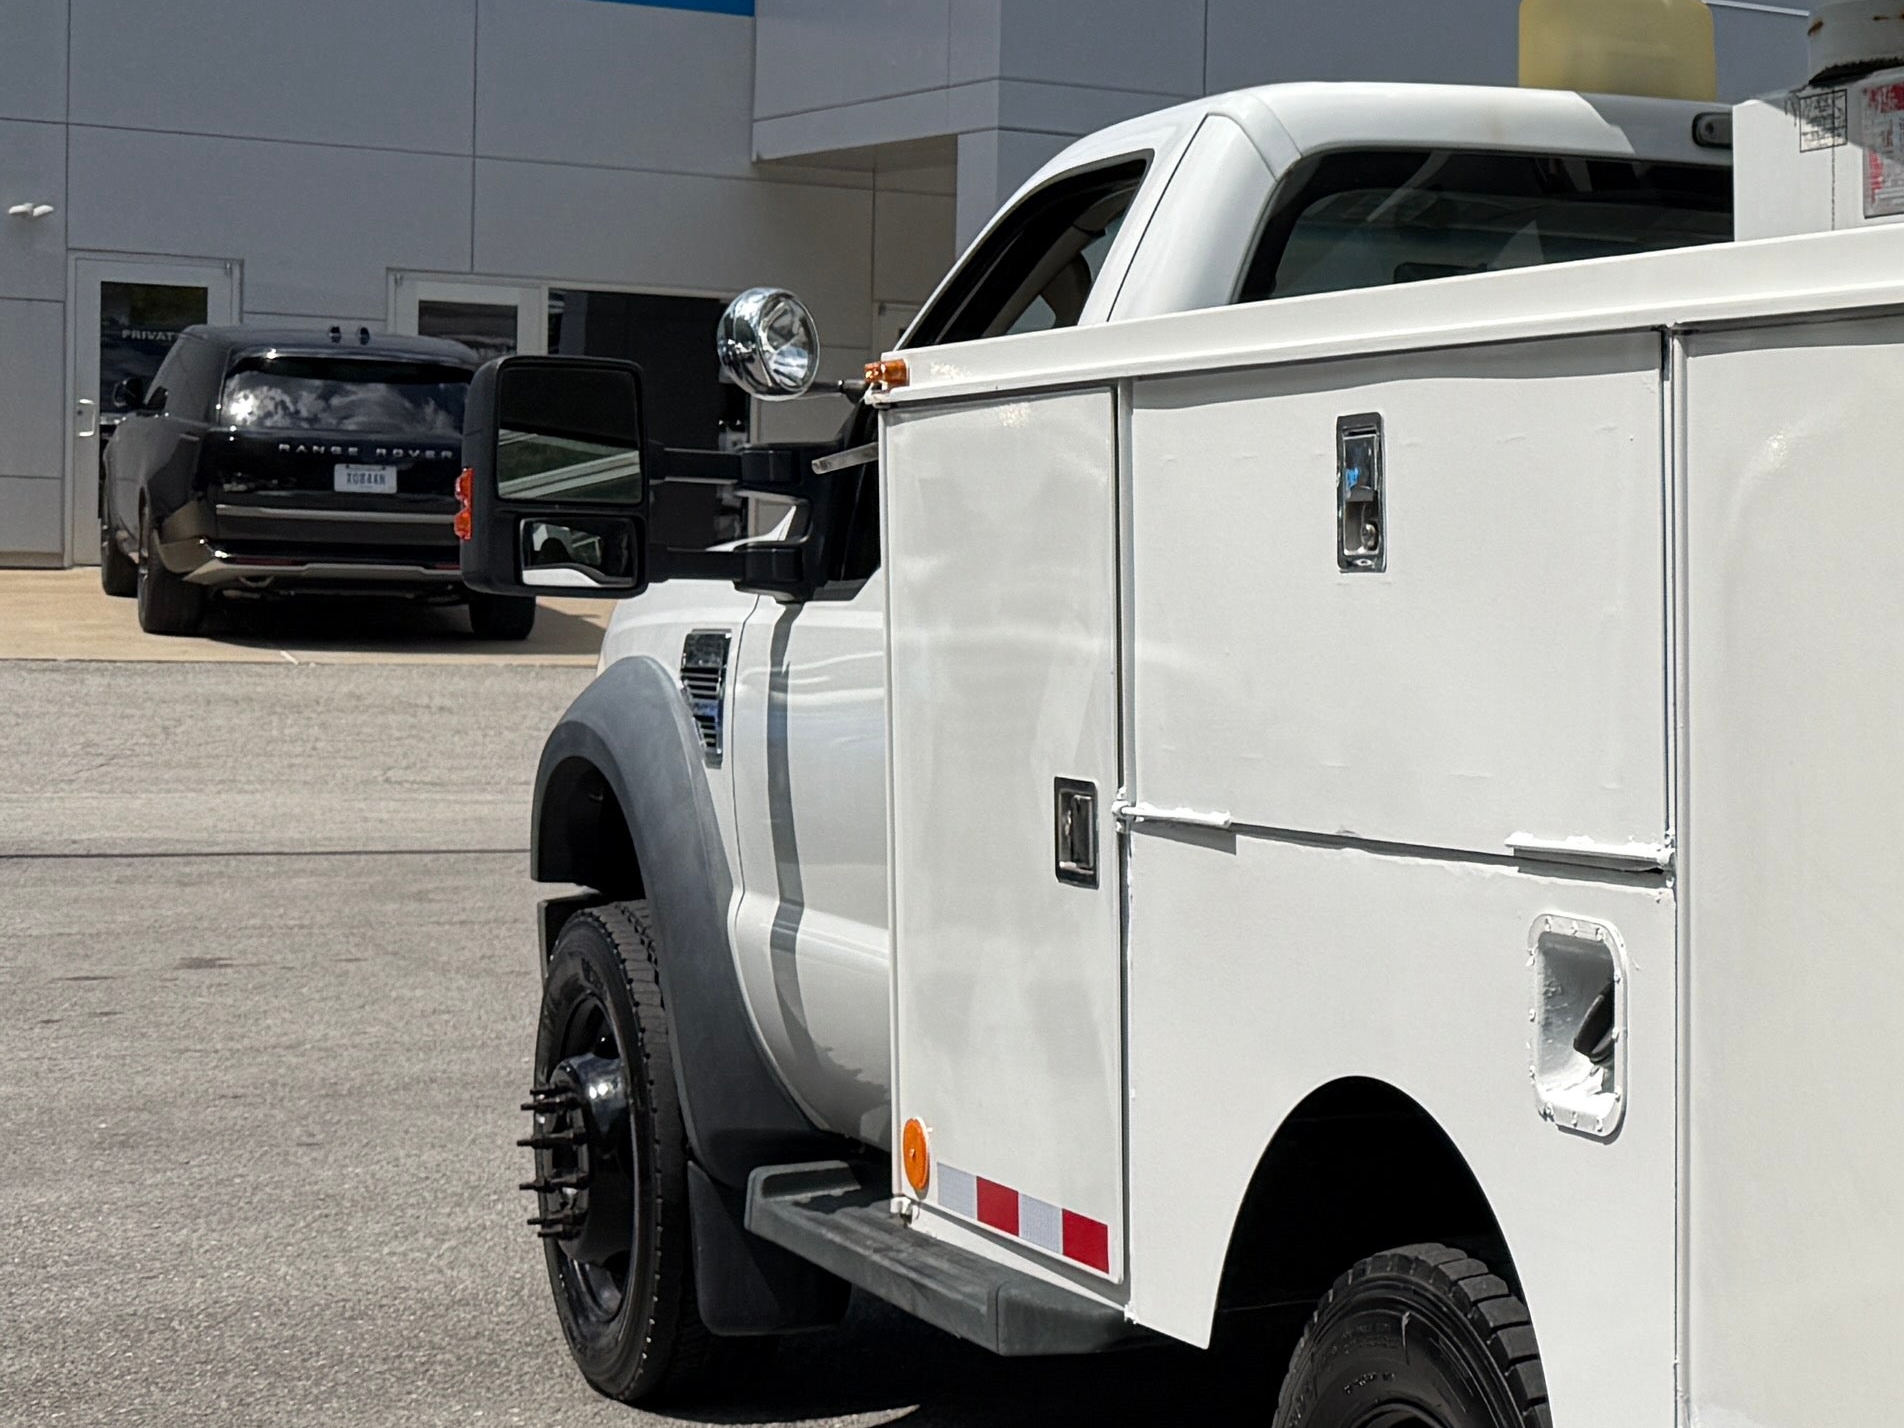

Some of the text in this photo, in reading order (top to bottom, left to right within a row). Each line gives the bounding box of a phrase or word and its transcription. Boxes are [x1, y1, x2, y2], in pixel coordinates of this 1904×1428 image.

[121, 329, 175, 341] PRIVAT
[278, 443, 452, 459] RANGE ROVER
